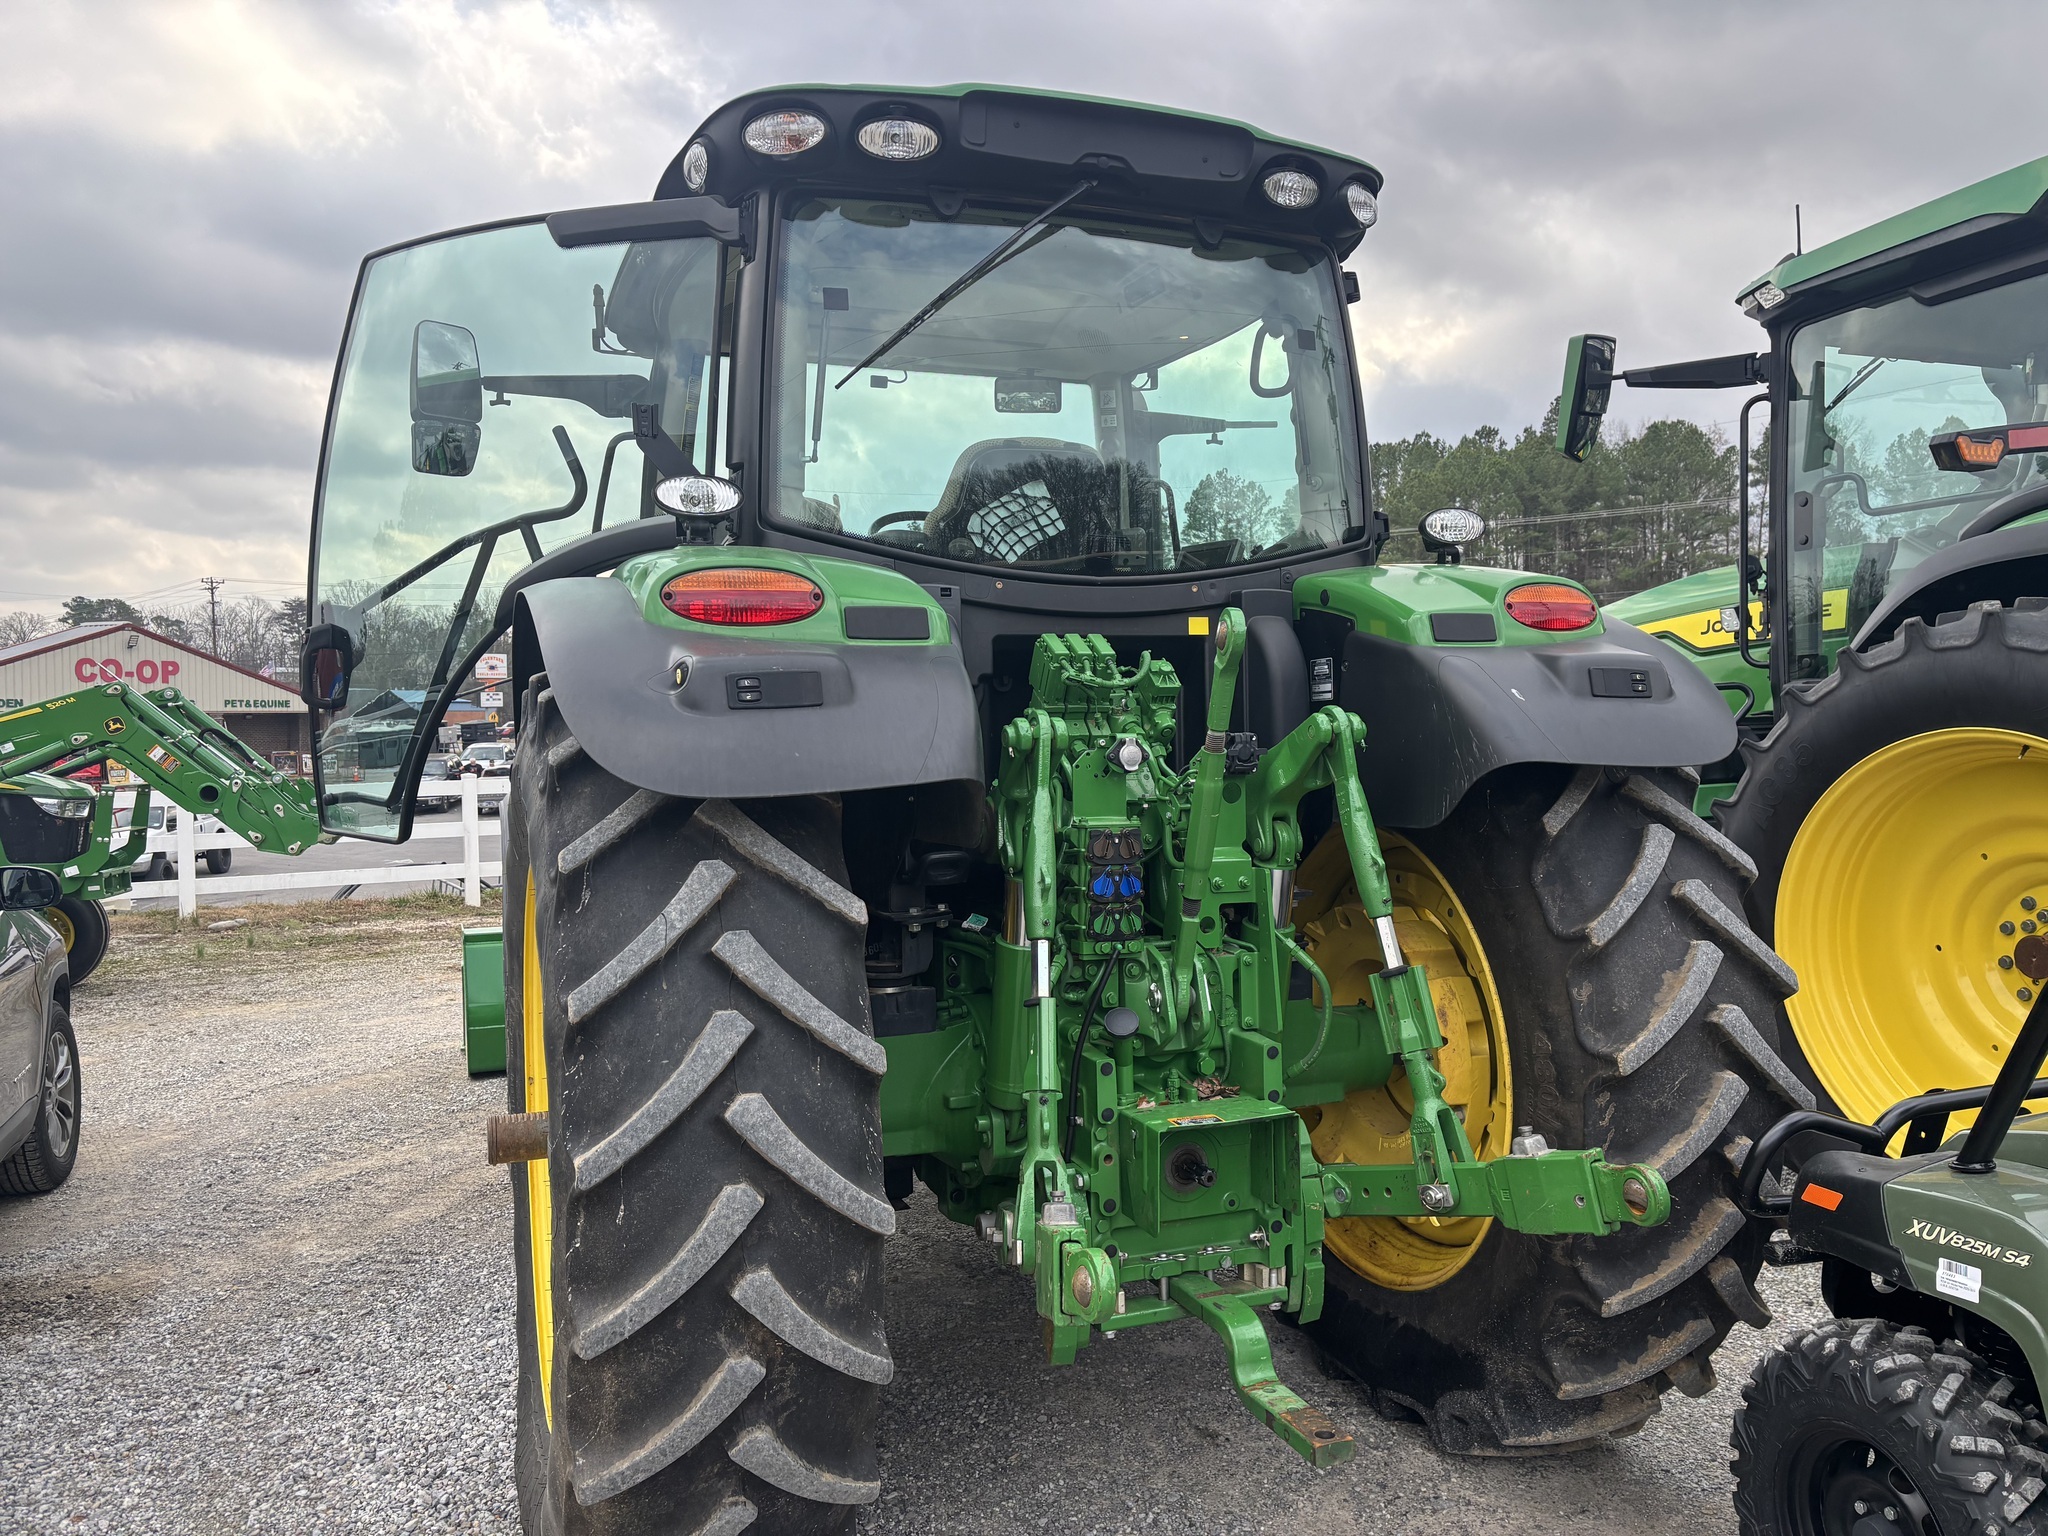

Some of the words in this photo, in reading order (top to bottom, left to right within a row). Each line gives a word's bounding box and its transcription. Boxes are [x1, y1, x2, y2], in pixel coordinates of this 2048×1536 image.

[75, 658, 180, 684] CO-OP
[1905, 1218, 2002, 1259] XUV825M
[2002, 1250, 2033, 1267] S4
